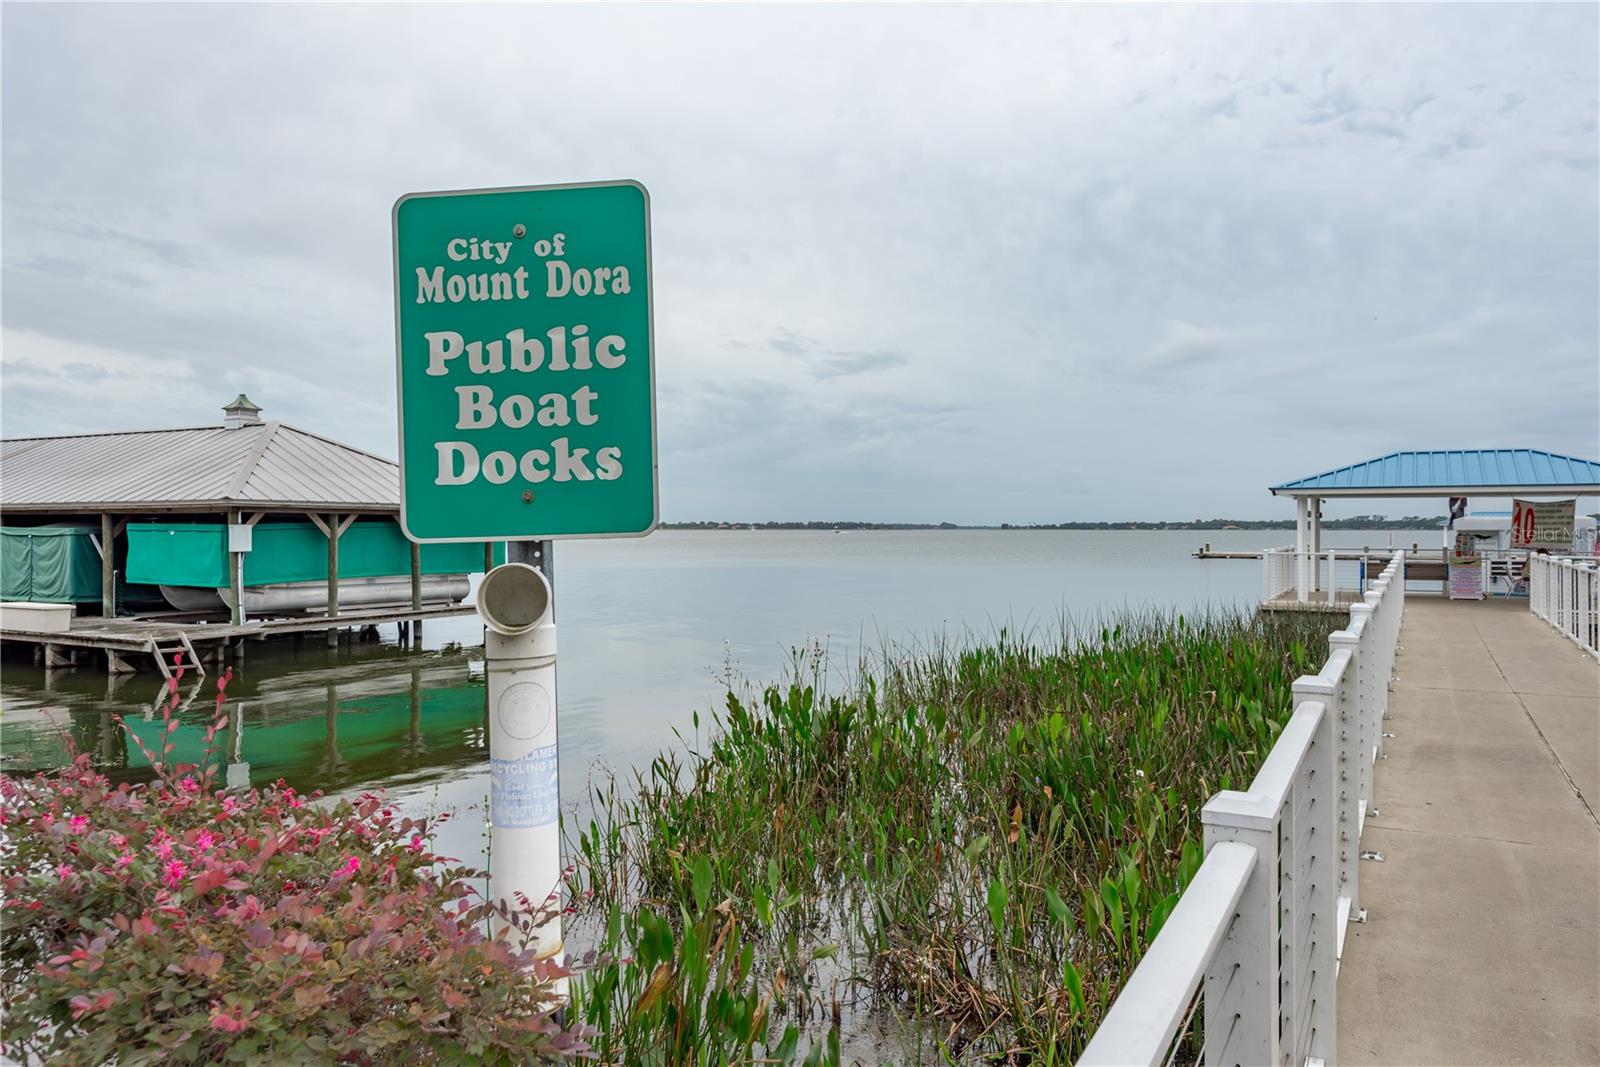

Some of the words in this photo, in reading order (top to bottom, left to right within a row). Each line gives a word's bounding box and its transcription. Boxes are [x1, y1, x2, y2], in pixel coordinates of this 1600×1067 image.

[447, 238, 512, 264] City
[534, 233, 565, 259] of
[416, 266, 530, 304] Mount
[545, 260, 631, 299] Dora
[424, 324, 627, 377] Public
[454, 385, 599, 430] Boat
[434, 437, 623, 486] Docks
